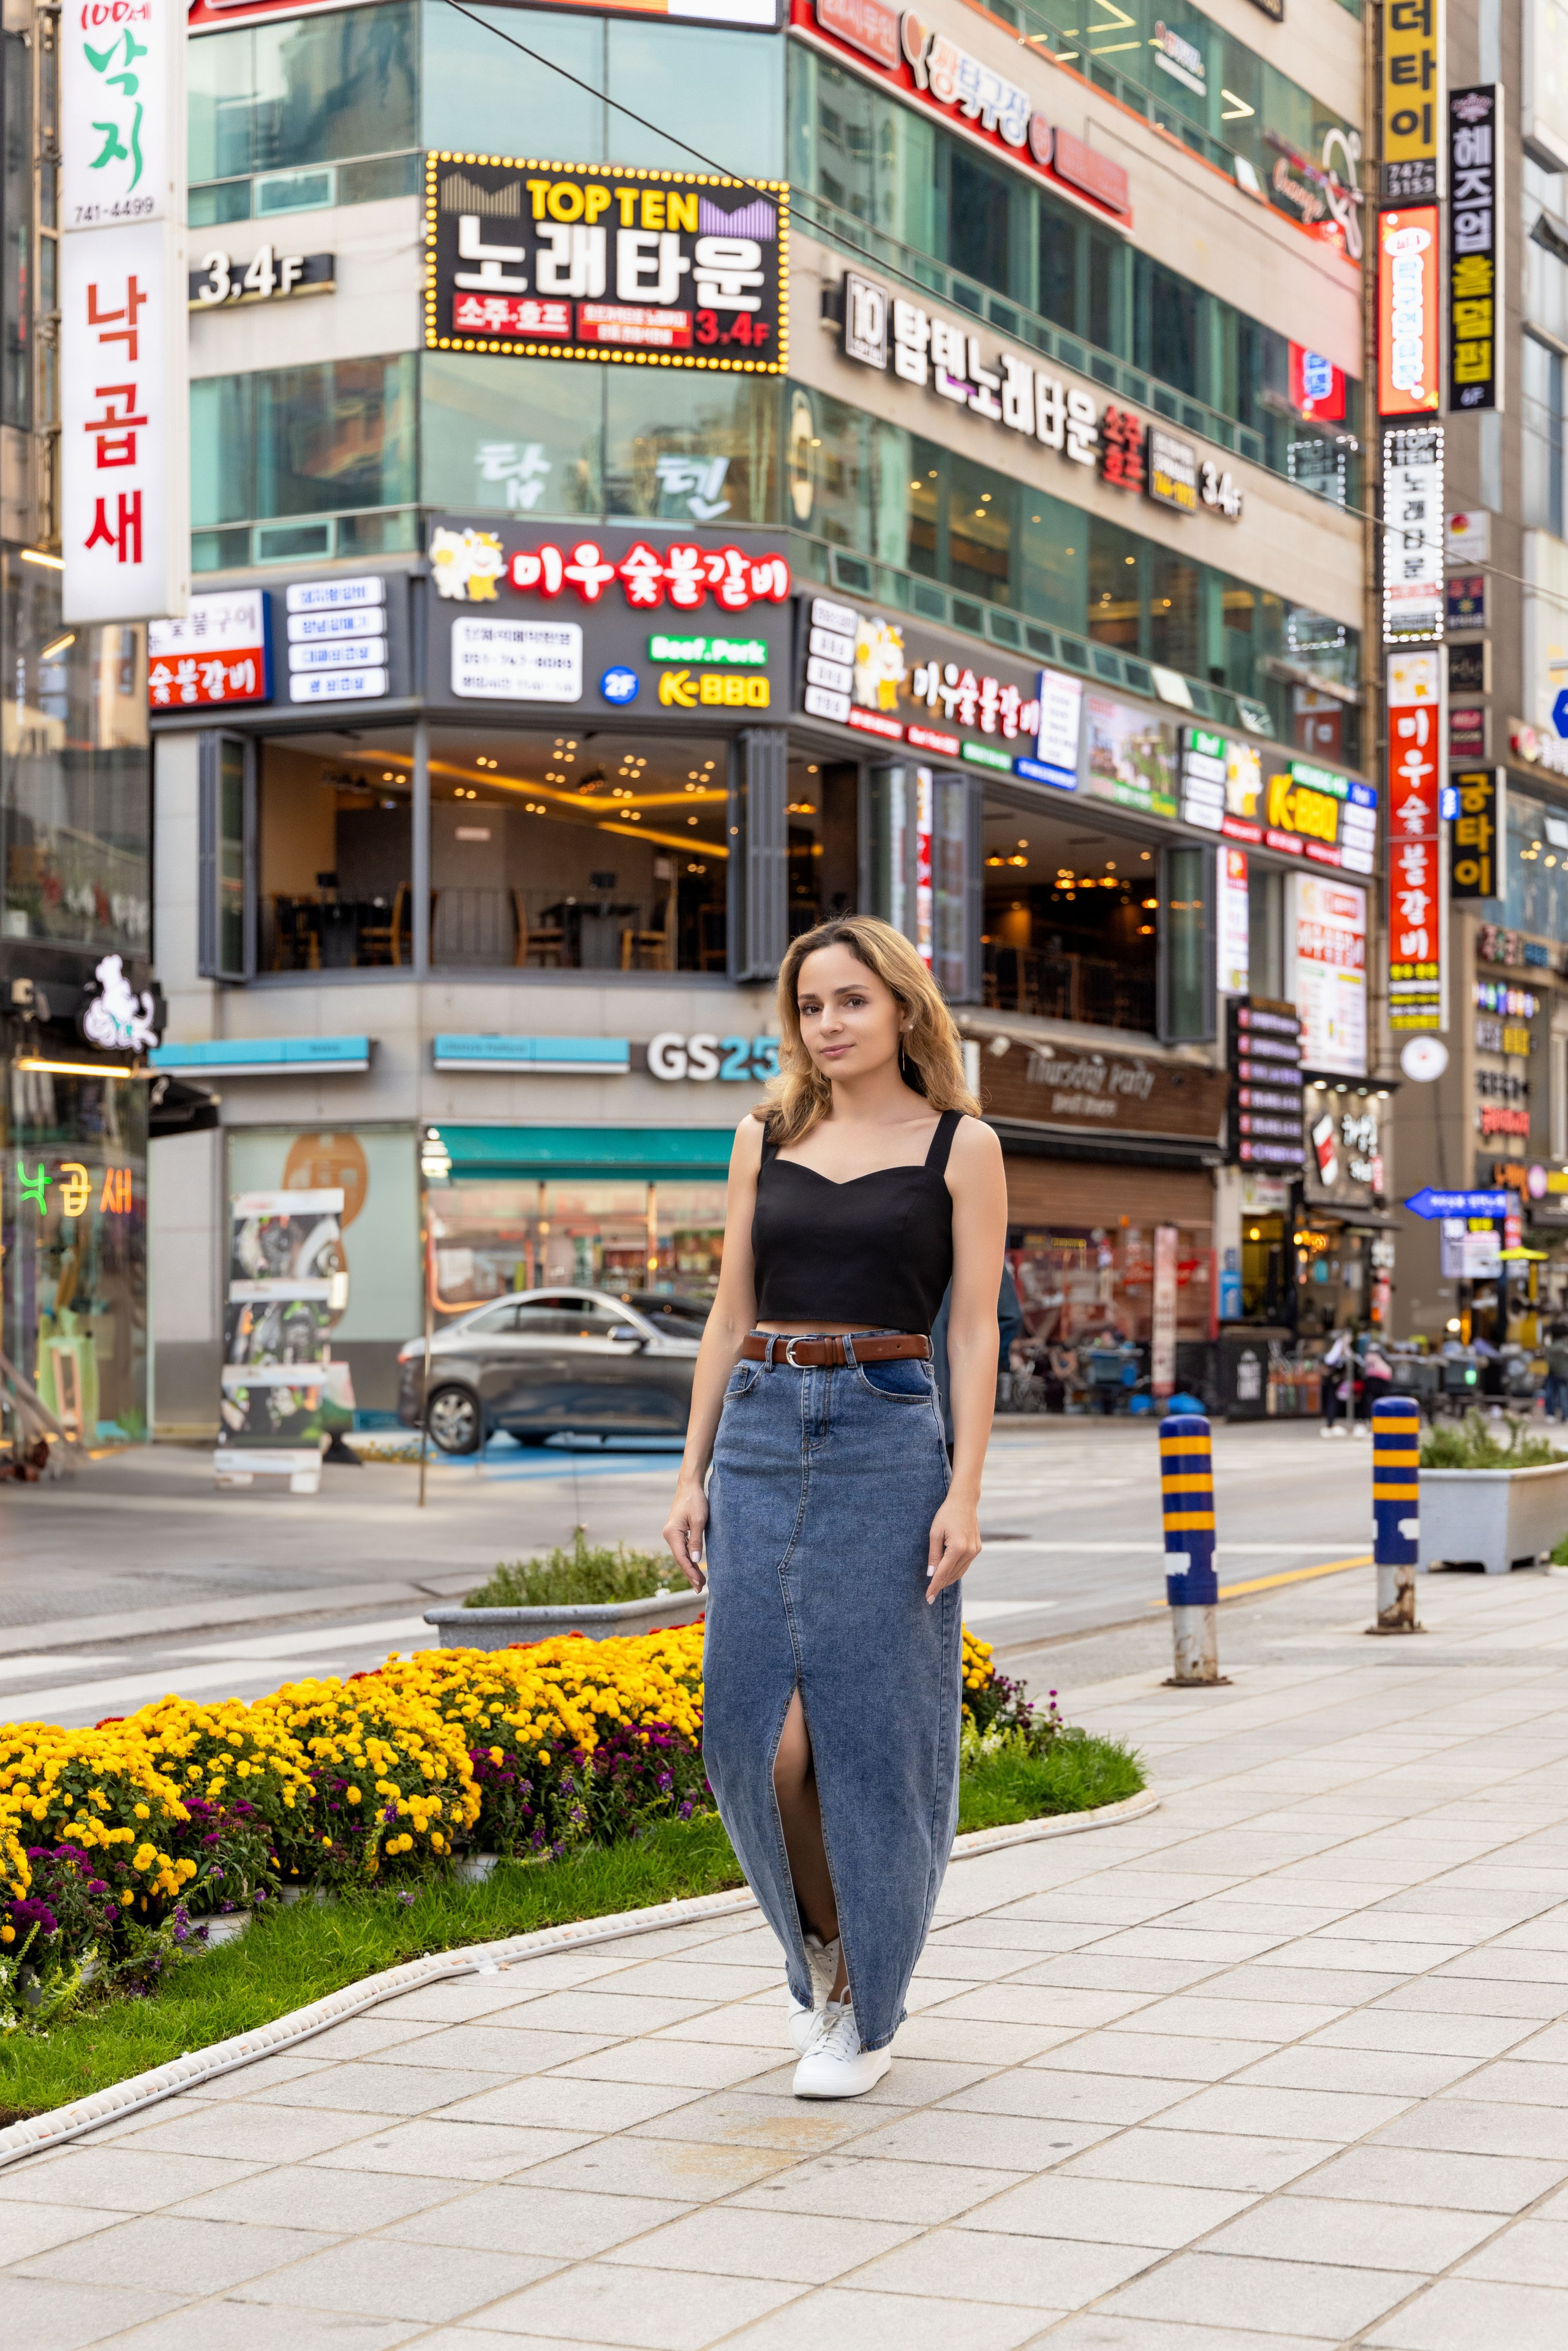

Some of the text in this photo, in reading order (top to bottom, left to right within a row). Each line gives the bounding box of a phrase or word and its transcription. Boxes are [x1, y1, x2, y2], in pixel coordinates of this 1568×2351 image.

[83, 28, 148, 194] 낙지
[75, 197, 154, 222] 741-4499
[526, 179, 699, 233] TOP TEN
[198, 244, 304, 305] 3,4F
[454, 214, 765, 312] 노래타운
[84, 274, 148, 564] 낙곱새
[511, 543, 788, 607] 미우 숯불갈비
[148, 657, 257, 704] 숯불갈비
[605, 673, 636, 697] 2F
[1396, 708, 1434, 960] 미우숯불갈비
[647, 1032, 782, 1081] GS25
[17, 1161, 132, 1217] 낙곱새
